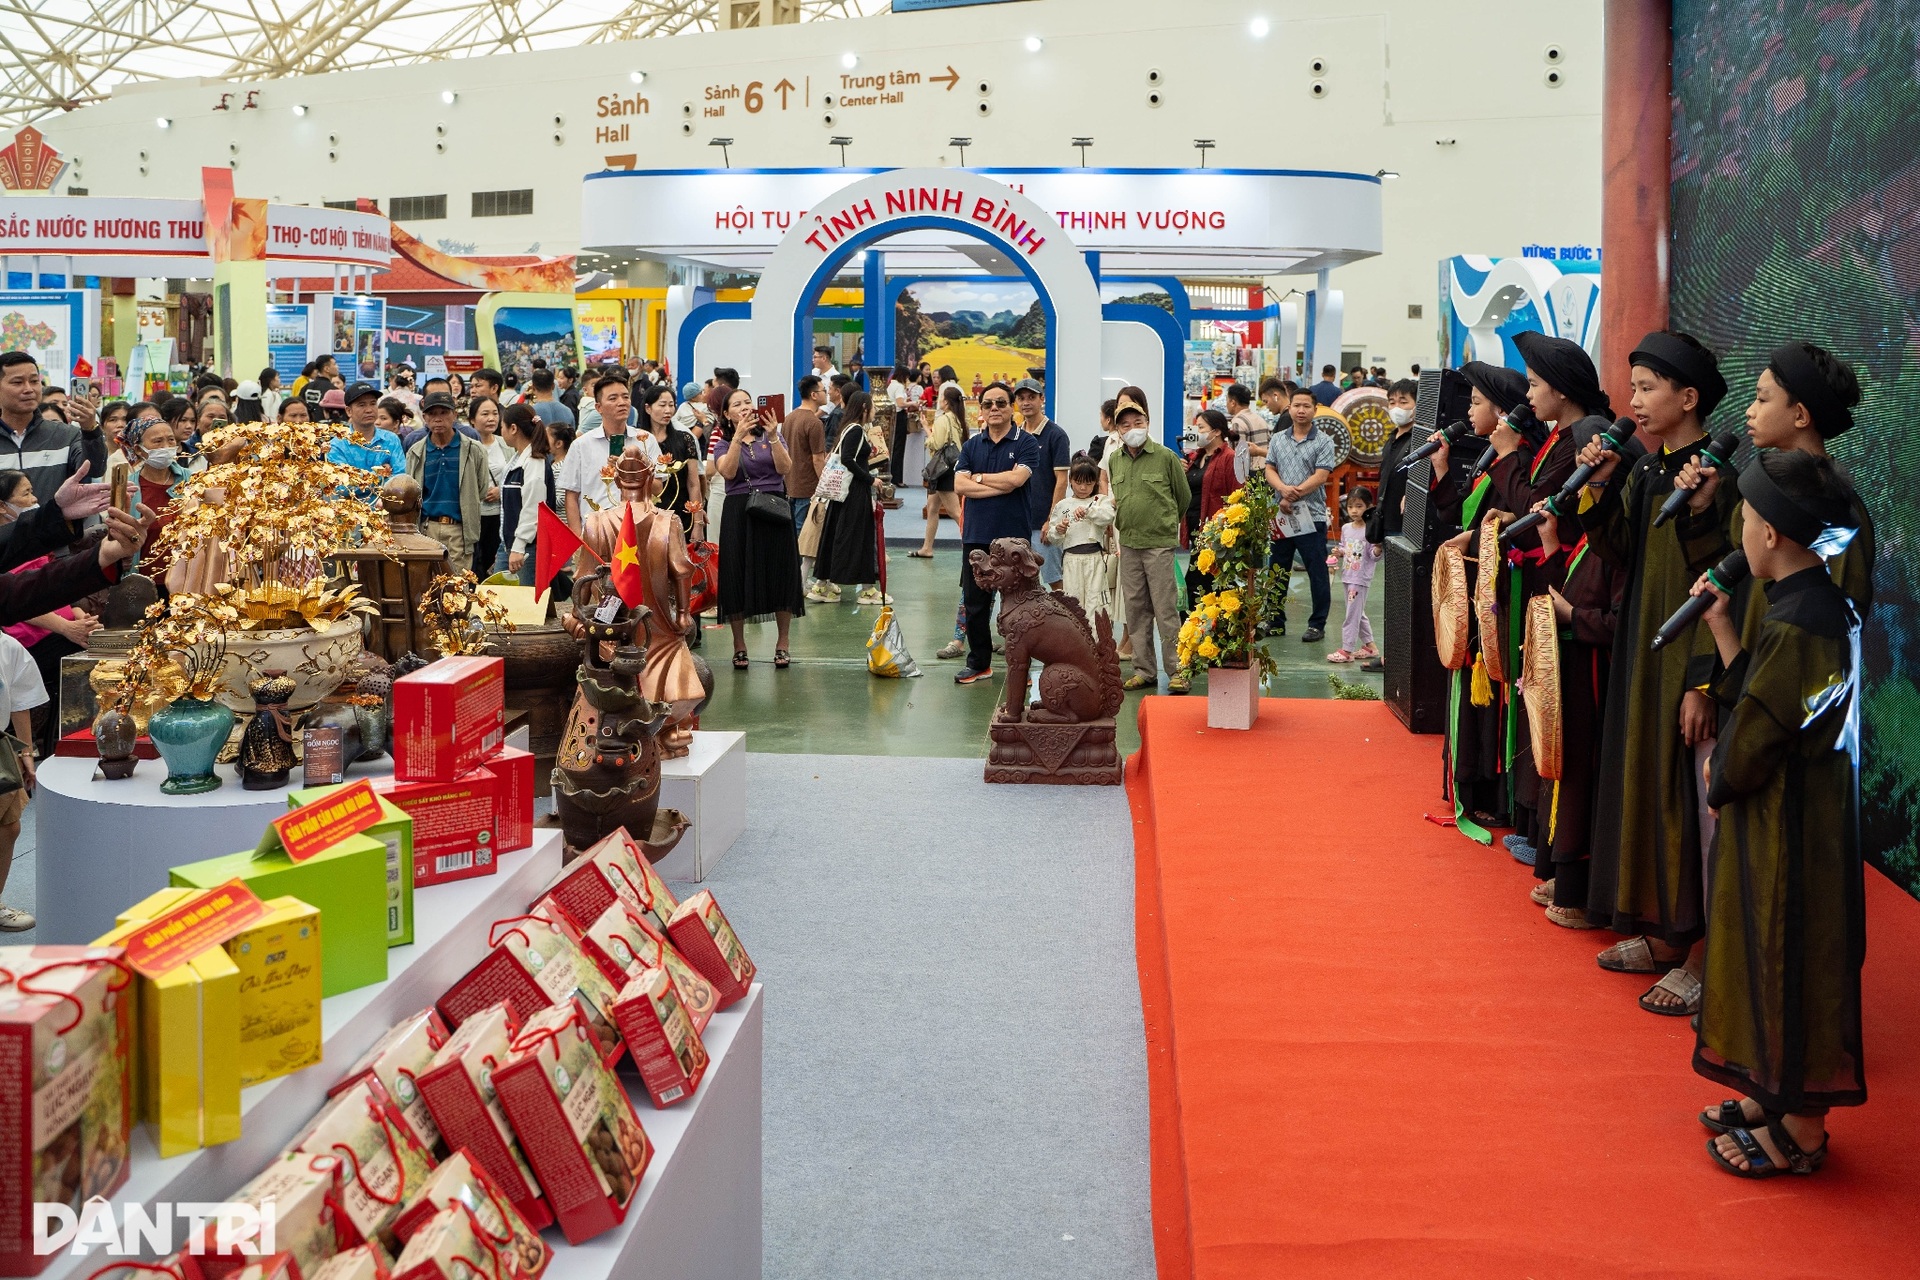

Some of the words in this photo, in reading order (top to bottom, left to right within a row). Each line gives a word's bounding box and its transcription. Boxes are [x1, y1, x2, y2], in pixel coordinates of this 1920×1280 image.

[840, 74, 885, 90] Trung
[890, 70, 920, 85] tâm
[597, 93, 649, 118] Sảnh
[705, 84, 740, 100] Sảnh
[744, 81, 763, 113] 6
[840, 95, 877, 107] Center
[880, 92, 903, 104] Hall
[704, 106, 724, 118] Hall
[596, 124, 629, 143] Hall
[0, 212, 30, 238] SẮC
[36, 214, 87, 238] NƯỚC
[94, 216, 161, 239] HƯƠNG
[715, 204, 754, 234] HỘI
[761, 211, 791, 234] TỤ
[805, 198, 876, 252] TỈNH
[885, 187, 963, 215] NINH
[971, 197, 1046, 255] BÌNH
[1056, 211, 1126, 234] THỊNH
[1137, 209, 1226, 236] VƯỢNG
[330, 226, 348, 250] HỘI
[1522, 243, 1556, 260] VỮNG
[1560, 243, 1592, 260] BƯỚC
